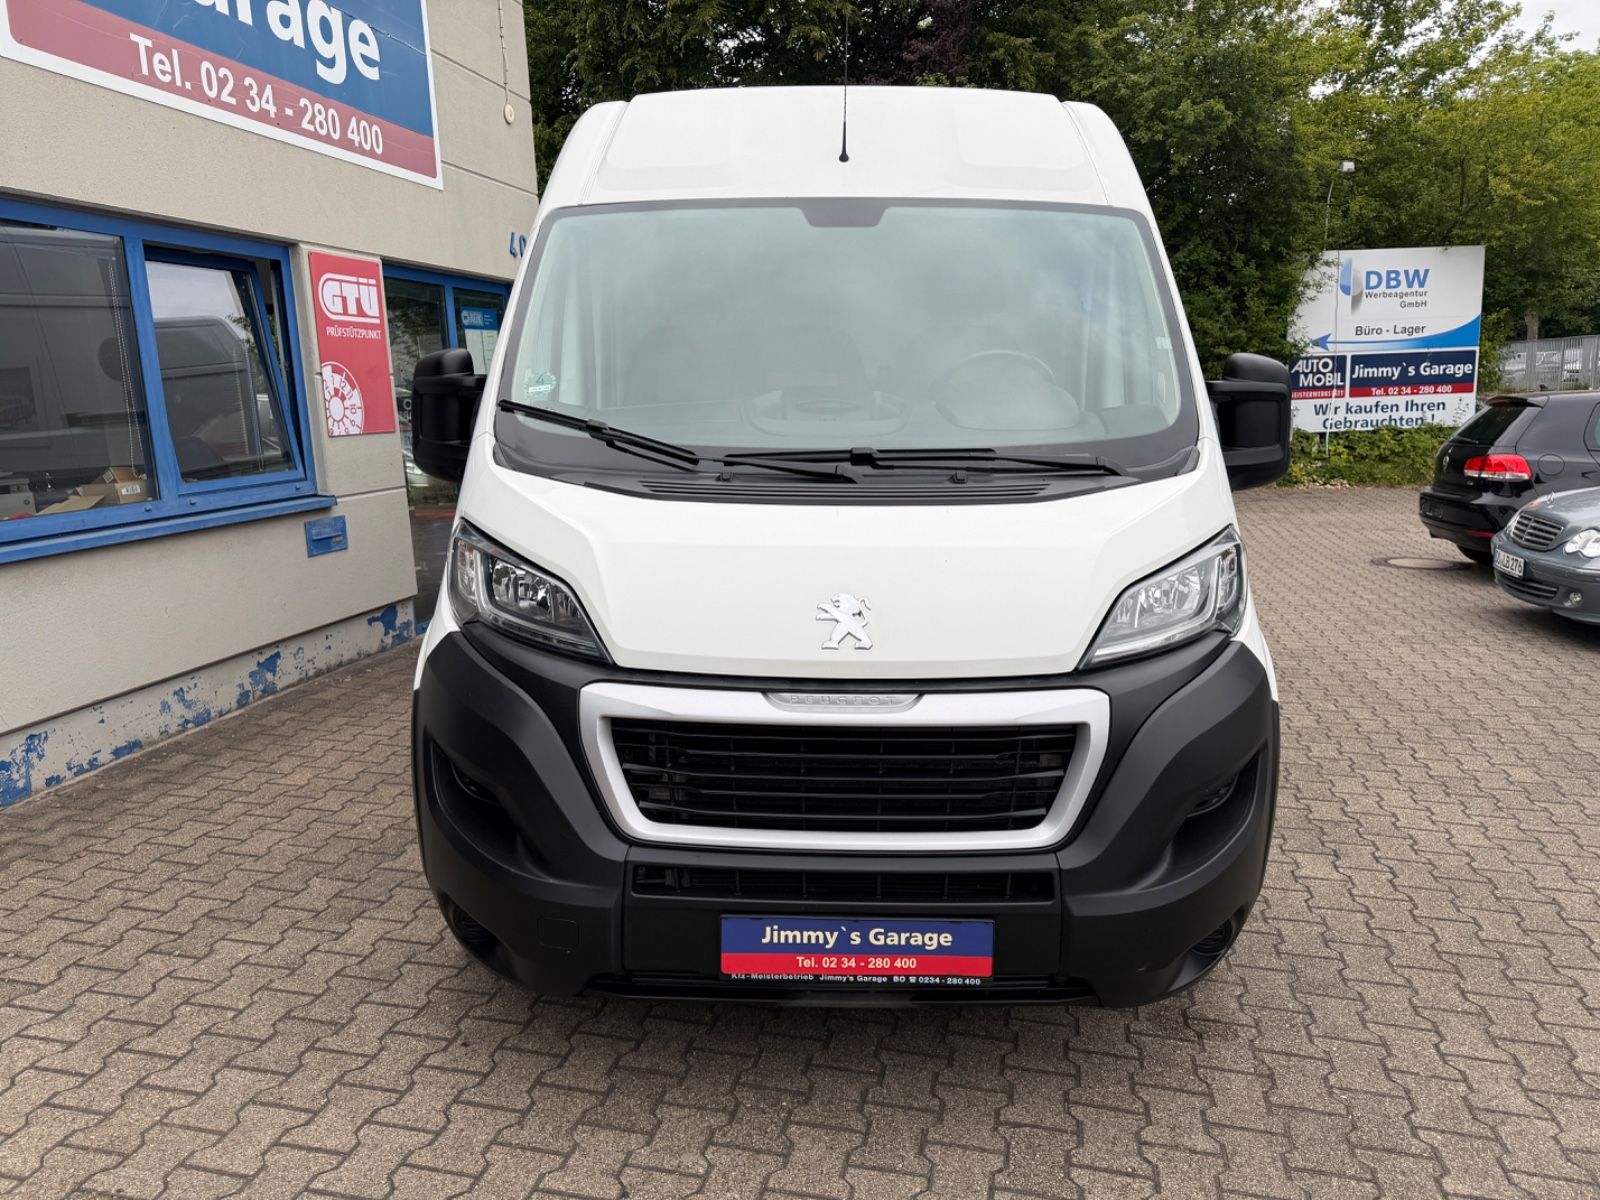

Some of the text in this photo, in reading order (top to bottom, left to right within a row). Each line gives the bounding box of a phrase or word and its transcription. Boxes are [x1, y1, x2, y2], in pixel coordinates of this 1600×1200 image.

[199, 0, 381, 84] age
[130, 33, 191, 90] Tel.
[201, 60, 236, 105] 02
[244, 76, 277, 119] 34
[300, 97, 341, 141] 280
[347, 116, 383, 156] 400
[1365, 269, 1430, 291] DBW
[321, 276, 380, 318] GTÜ
[1365, 290, 1428, 300] Werbeagentur
[1400, 300, 1428, 309] GmbH
[326, 325, 382, 339] PRÜFSTÜTZPUNKT
[1355, 325, 1383, 336] Büro
[1393, 324, 1426, 336] Lager
[1291, 358, 1333, 373] AUTO
[1420, 361, 1473, 377] Garage
[1299, 372, 1344, 387] MOBIL
[1371, 387, 1386, 396] Tel.
[1388, 387, 1399, 395] 02
[1400, 386, 1412, 394] 34
[1436, 385, 1452, 393] 400
[1345, 401, 1399, 414] kaufen
[1405, 400, 1446, 413] Ihren
[1322, 415, 1424, 430] Gebrauchten
[790, 695, 897, 705] PEUGEOT
[868, 928, 953, 950] Garage
[796, 956, 819, 969] Tel.
[822, 957, 838, 969] 02
[841, 957, 856, 969] 34
[868, 957, 891, 969] 280
[894, 958, 917, 969] 400
[857, 975, 888, 984] Garage
[919, 976, 940, 984] 0234
[964, 978, 981, 986] 400
